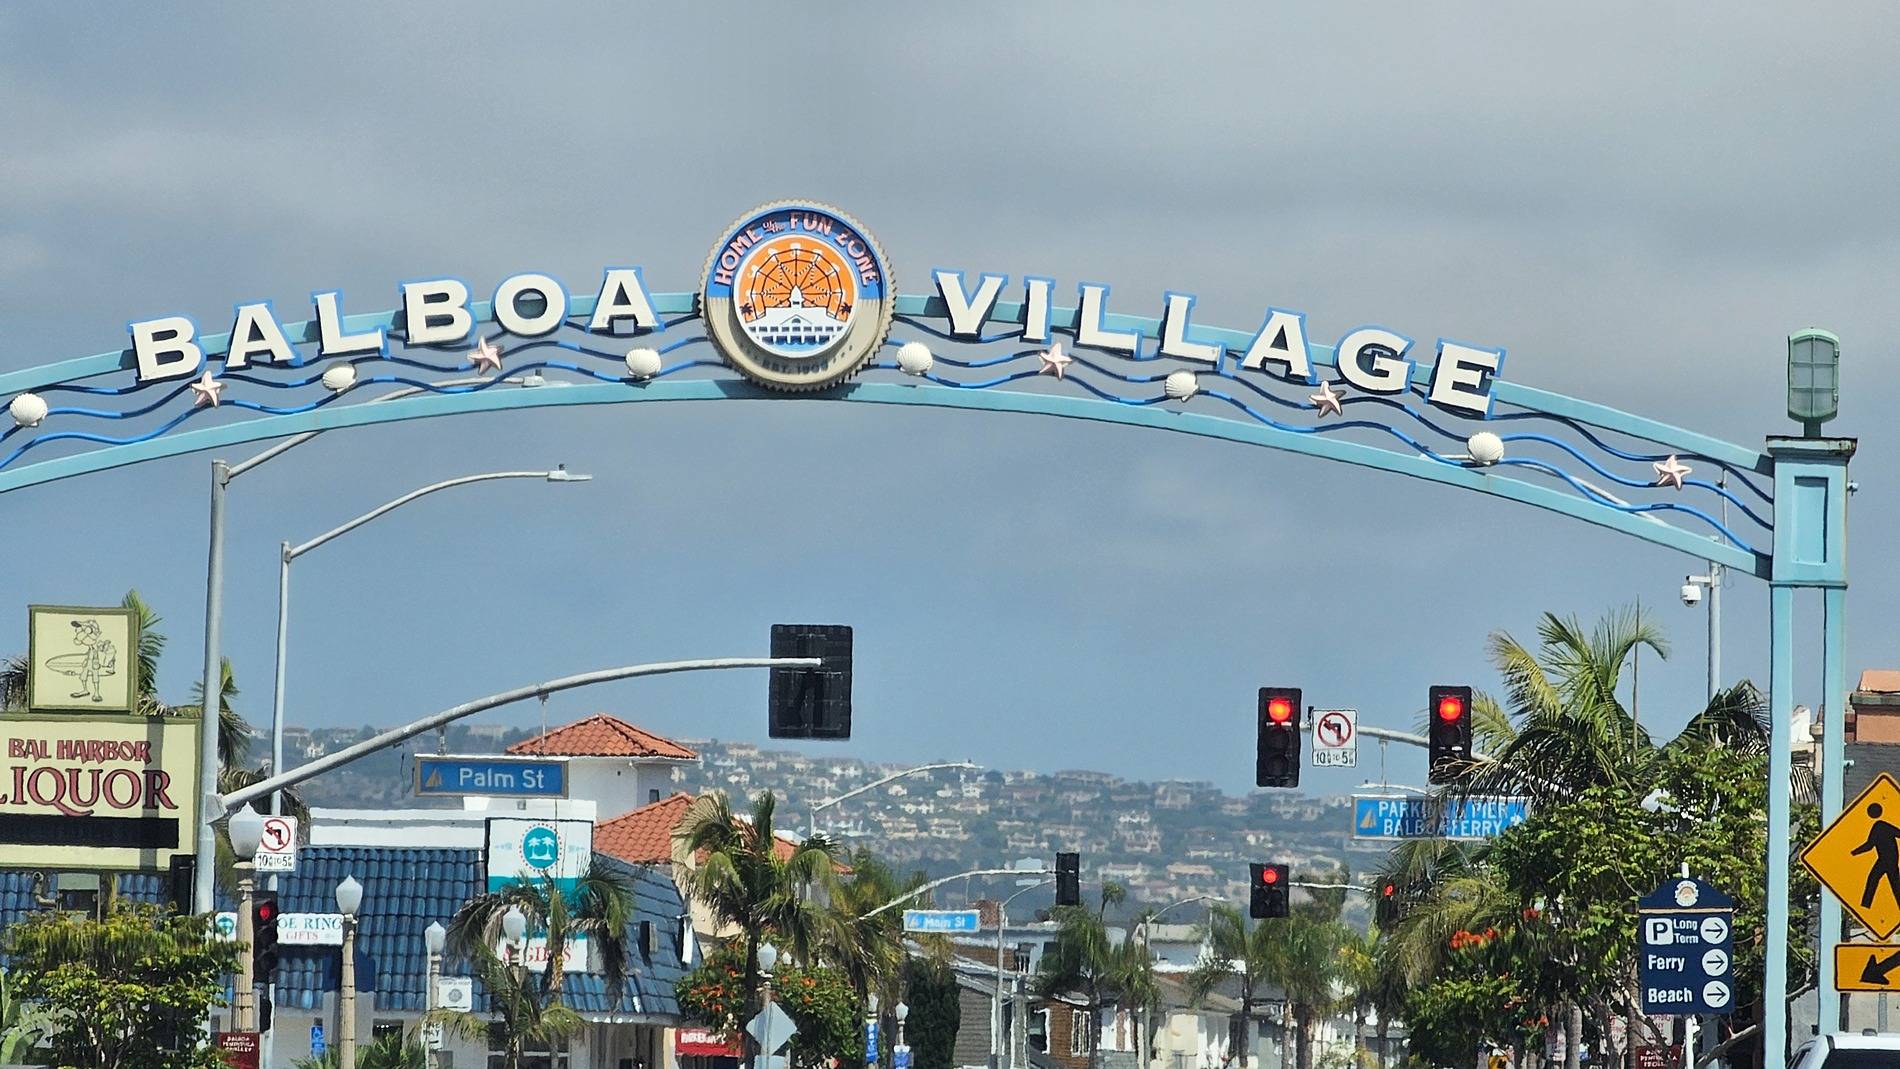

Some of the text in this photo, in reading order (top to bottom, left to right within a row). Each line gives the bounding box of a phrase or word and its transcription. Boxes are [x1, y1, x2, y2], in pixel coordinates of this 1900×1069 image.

[714, 227, 763, 286] HOME
[790, 212, 833, 236] FUN
[835, 230, 880, 287] ZONE
[128, 267, 1504, 419] BALBOA VILLAGE
[8, 738, 153, 765] BAL HARBOR
[459, 767, 545, 789] Palm St
[0, 766, 179, 817] IQUOR
[924, 916, 966, 929] Main St
[1673, 918, 1698, 931] Long
[1674, 932, 1699, 944] Term
[1648, 953, 1685, 972] Ferry
[1648, 987, 1693, 1003] Beach
